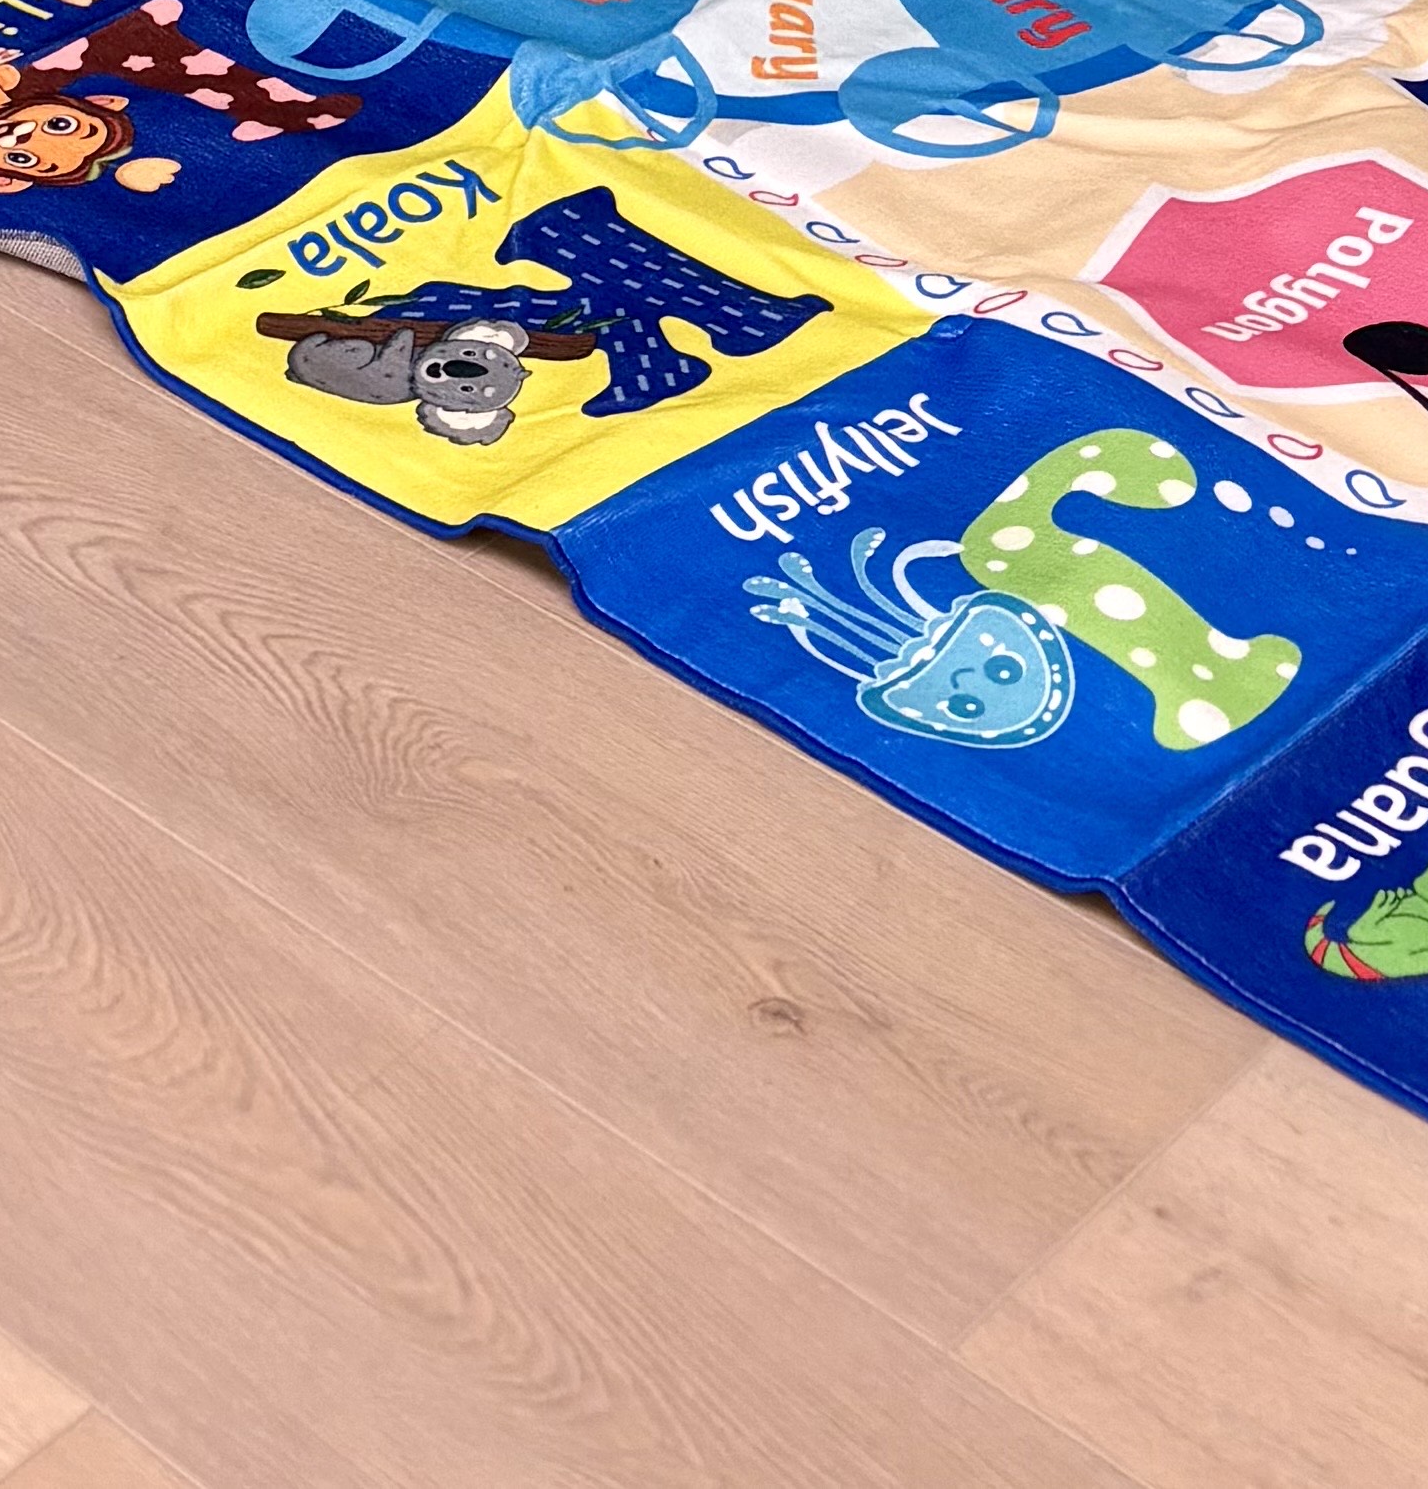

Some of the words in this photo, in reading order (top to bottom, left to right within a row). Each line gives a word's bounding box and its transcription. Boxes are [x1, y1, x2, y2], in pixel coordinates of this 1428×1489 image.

[289, 157, 502, 278] Koala
[1200, 207, 1416, 343] Polygon
[709, 393, 963, 544] Jellyfish
